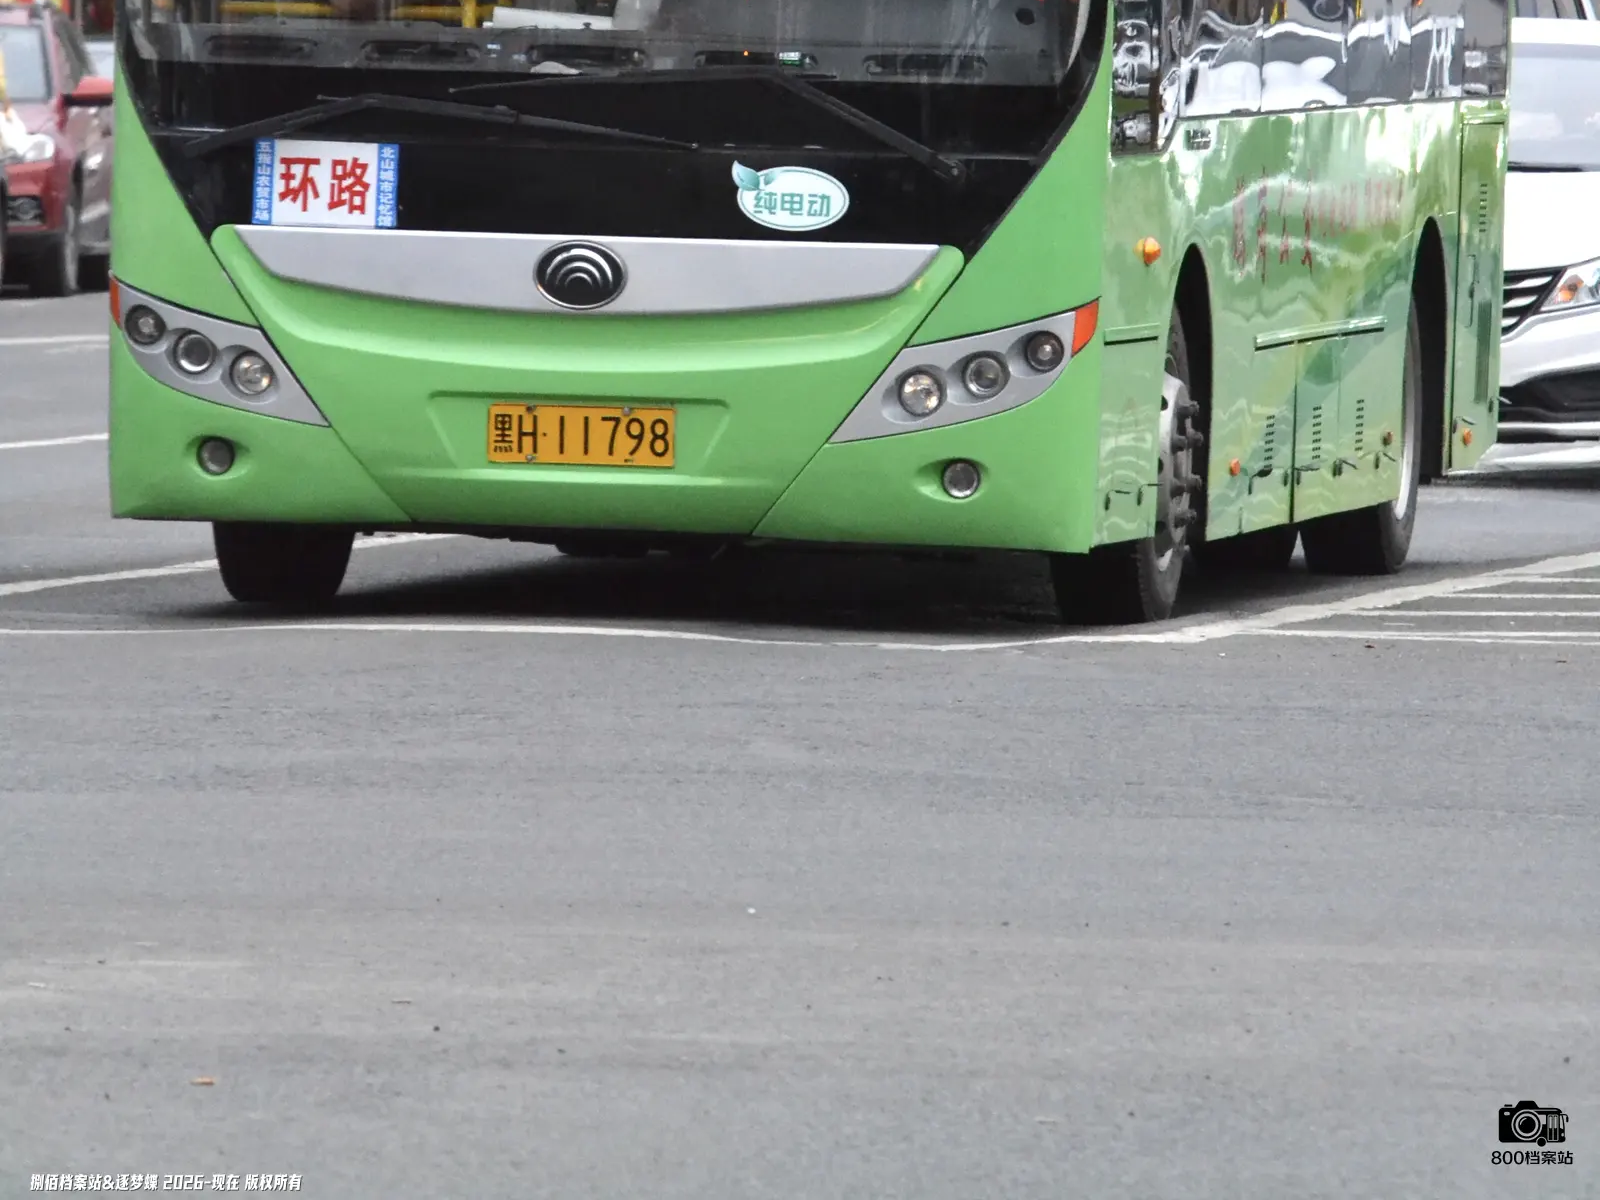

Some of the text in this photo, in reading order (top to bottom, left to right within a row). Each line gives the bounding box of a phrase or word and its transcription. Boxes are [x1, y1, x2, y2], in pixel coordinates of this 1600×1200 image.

[278, 156, 371, 216] 环路
[753, 191, 831, 218] 纯电动
